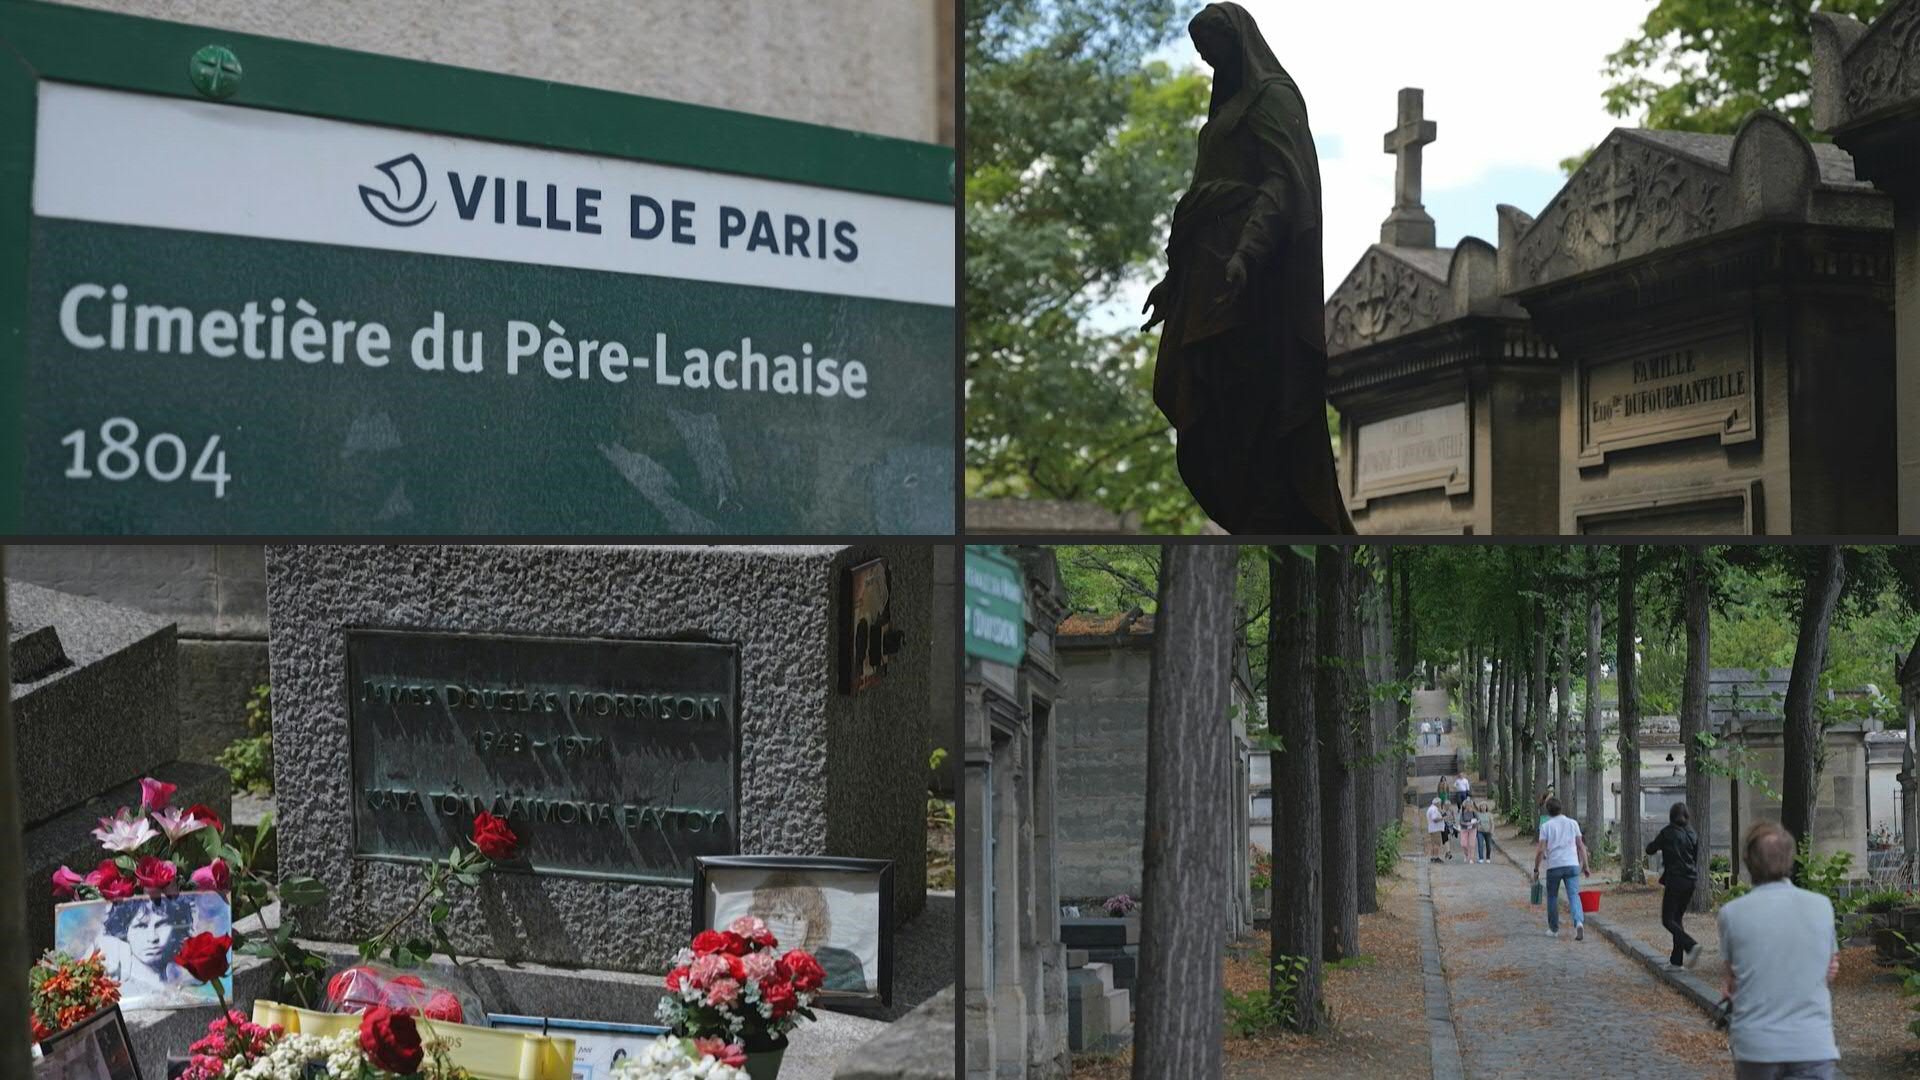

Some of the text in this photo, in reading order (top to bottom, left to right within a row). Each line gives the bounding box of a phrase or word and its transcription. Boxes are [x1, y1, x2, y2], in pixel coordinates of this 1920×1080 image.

[447, 171, 859, 263] VILLE DE PARIS
[60, 284, 869, 399] Cimetière du Père-Lachaise
[1632, 350, 1696, 384] FAMILLE
[1624, 370, 1745, 417] DUFOURMANTELLE
[62, 418, 231, 498] 1804
[445, 684, 559, 713] DOUGLAS
[569, 690, 722, 721] MORRISON
